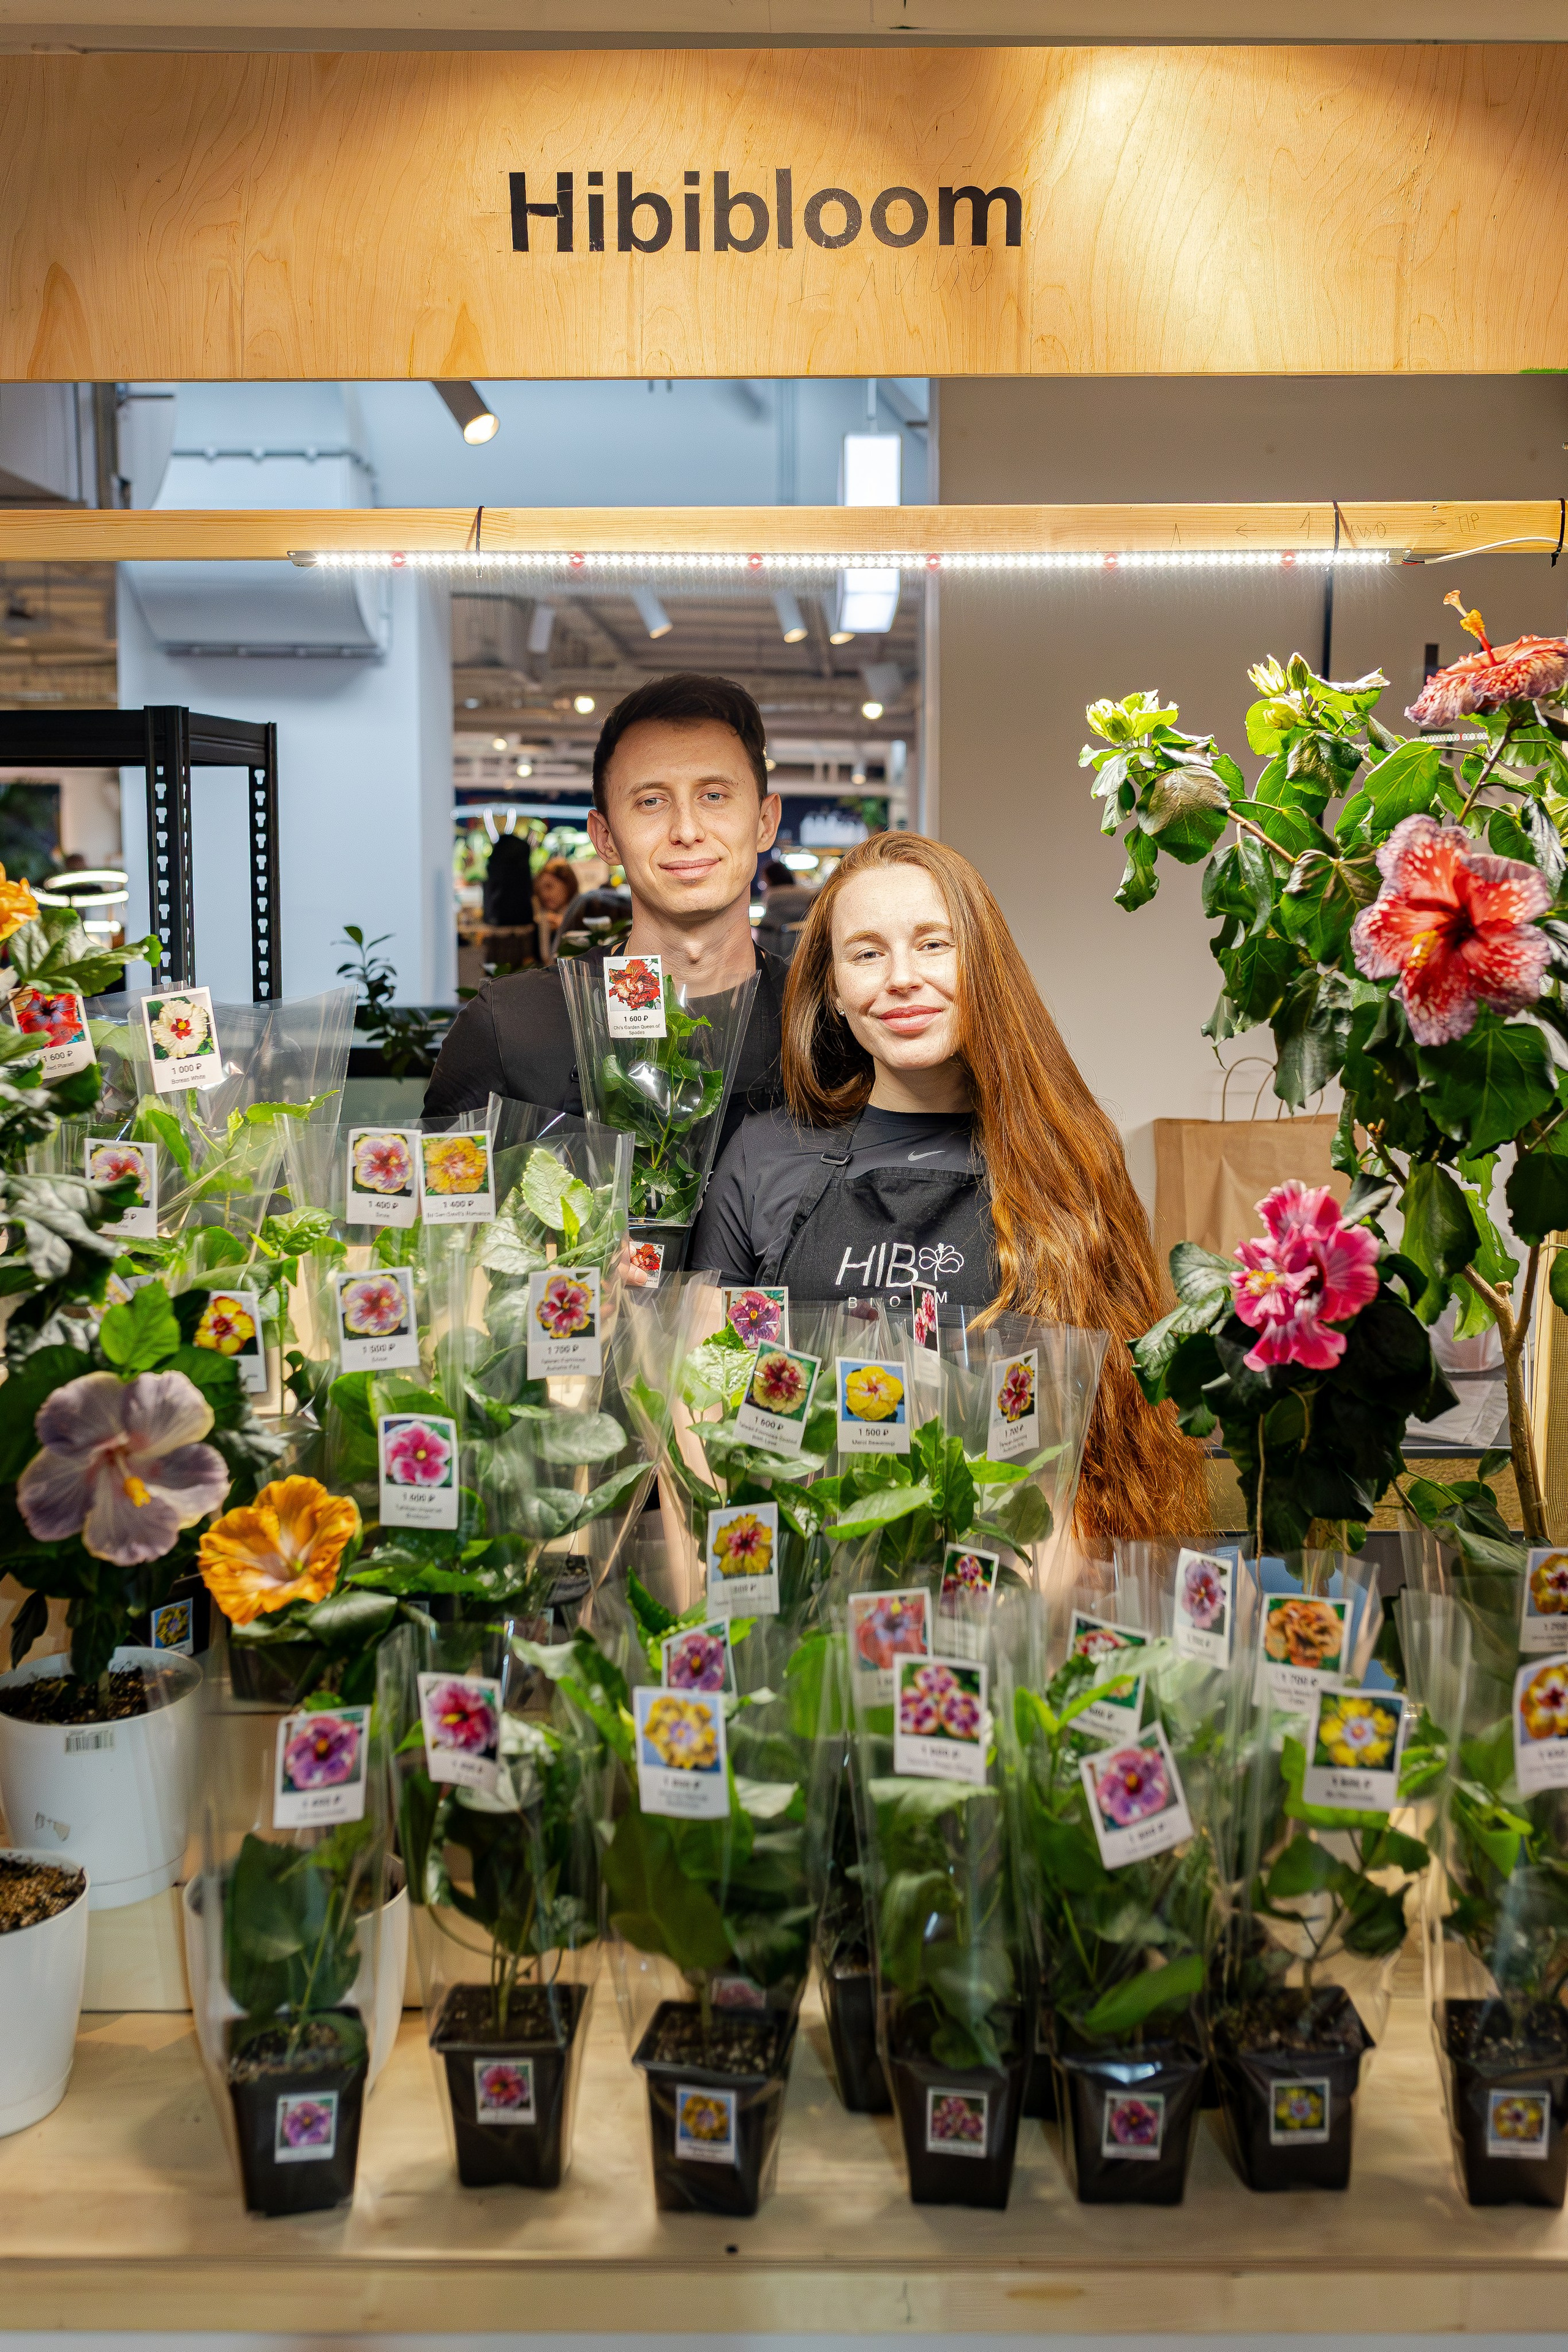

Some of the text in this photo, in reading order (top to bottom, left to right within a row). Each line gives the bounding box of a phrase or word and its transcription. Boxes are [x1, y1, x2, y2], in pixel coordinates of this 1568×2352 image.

[509, 168, 1022, 252] Hibibloom
[50, 1052, 66, 1061] 600
[179, 1064, 194, 1074] 000
